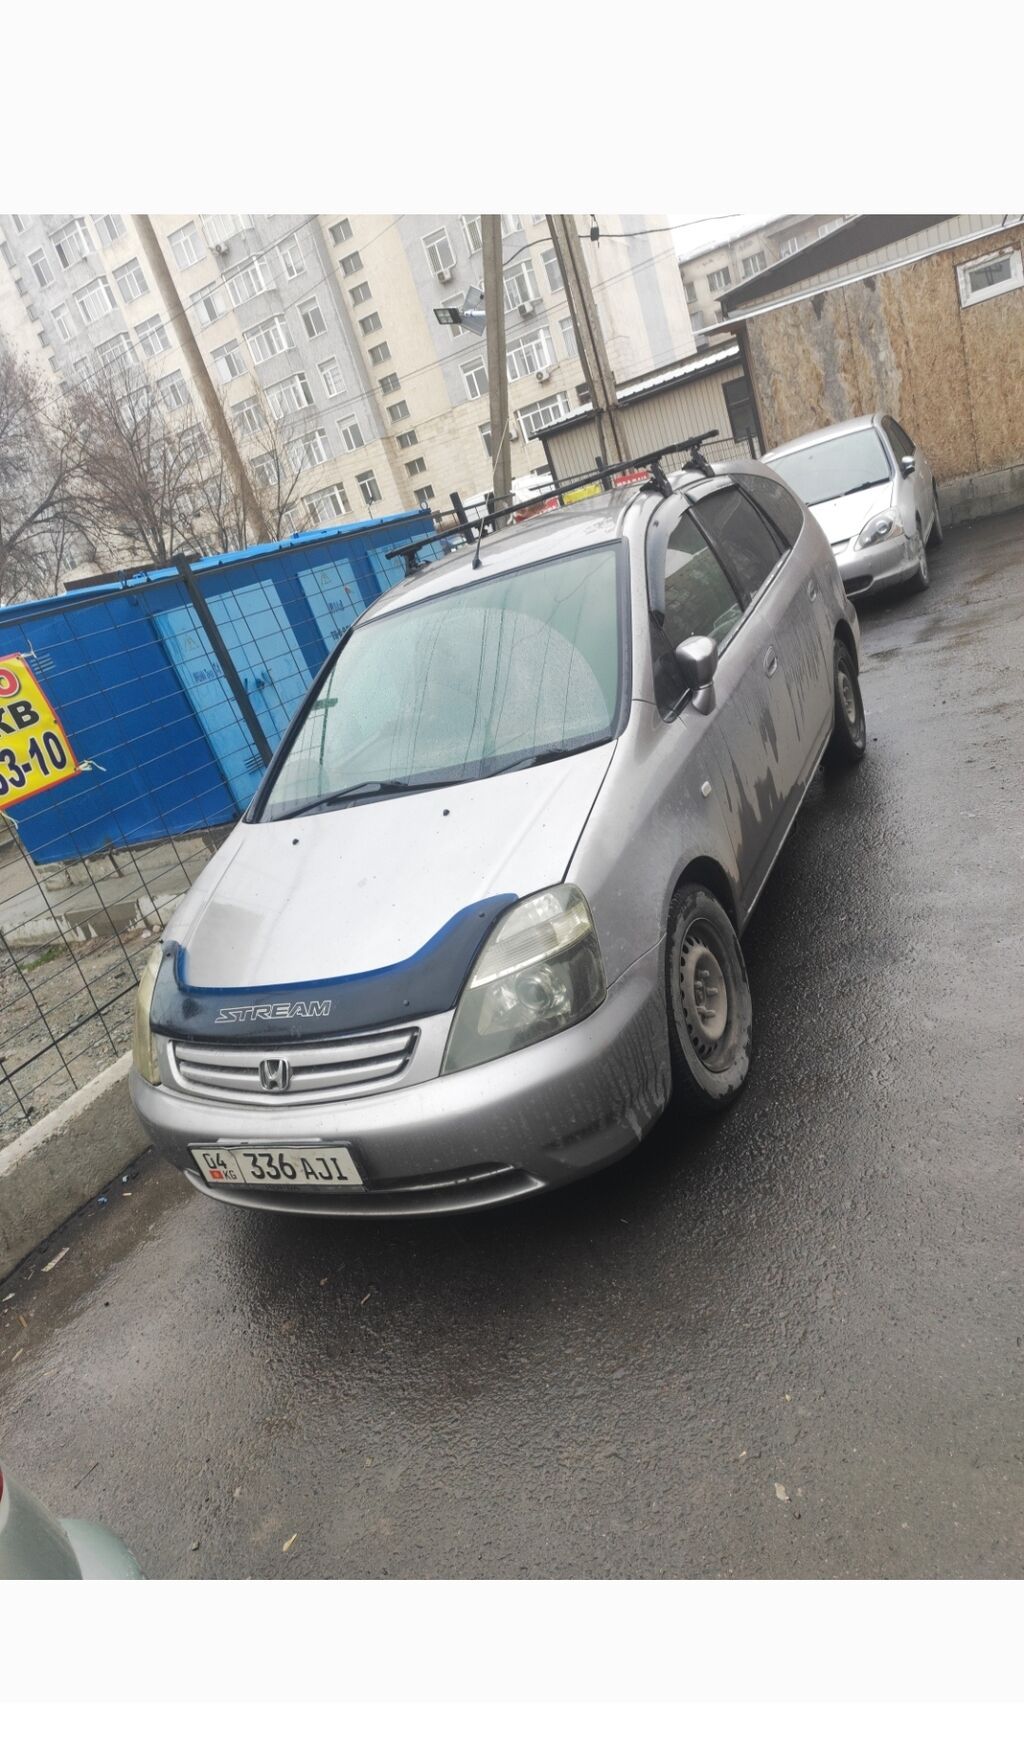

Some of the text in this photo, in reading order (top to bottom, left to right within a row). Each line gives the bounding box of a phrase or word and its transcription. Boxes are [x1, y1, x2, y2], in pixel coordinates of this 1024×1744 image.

[215, 1001, 332, 1023] STREAM
[223, 1170, 237, 1180] KG
[243, 1153, 297, 1180] 336
[300, 1157, 348, 1181] AJI
